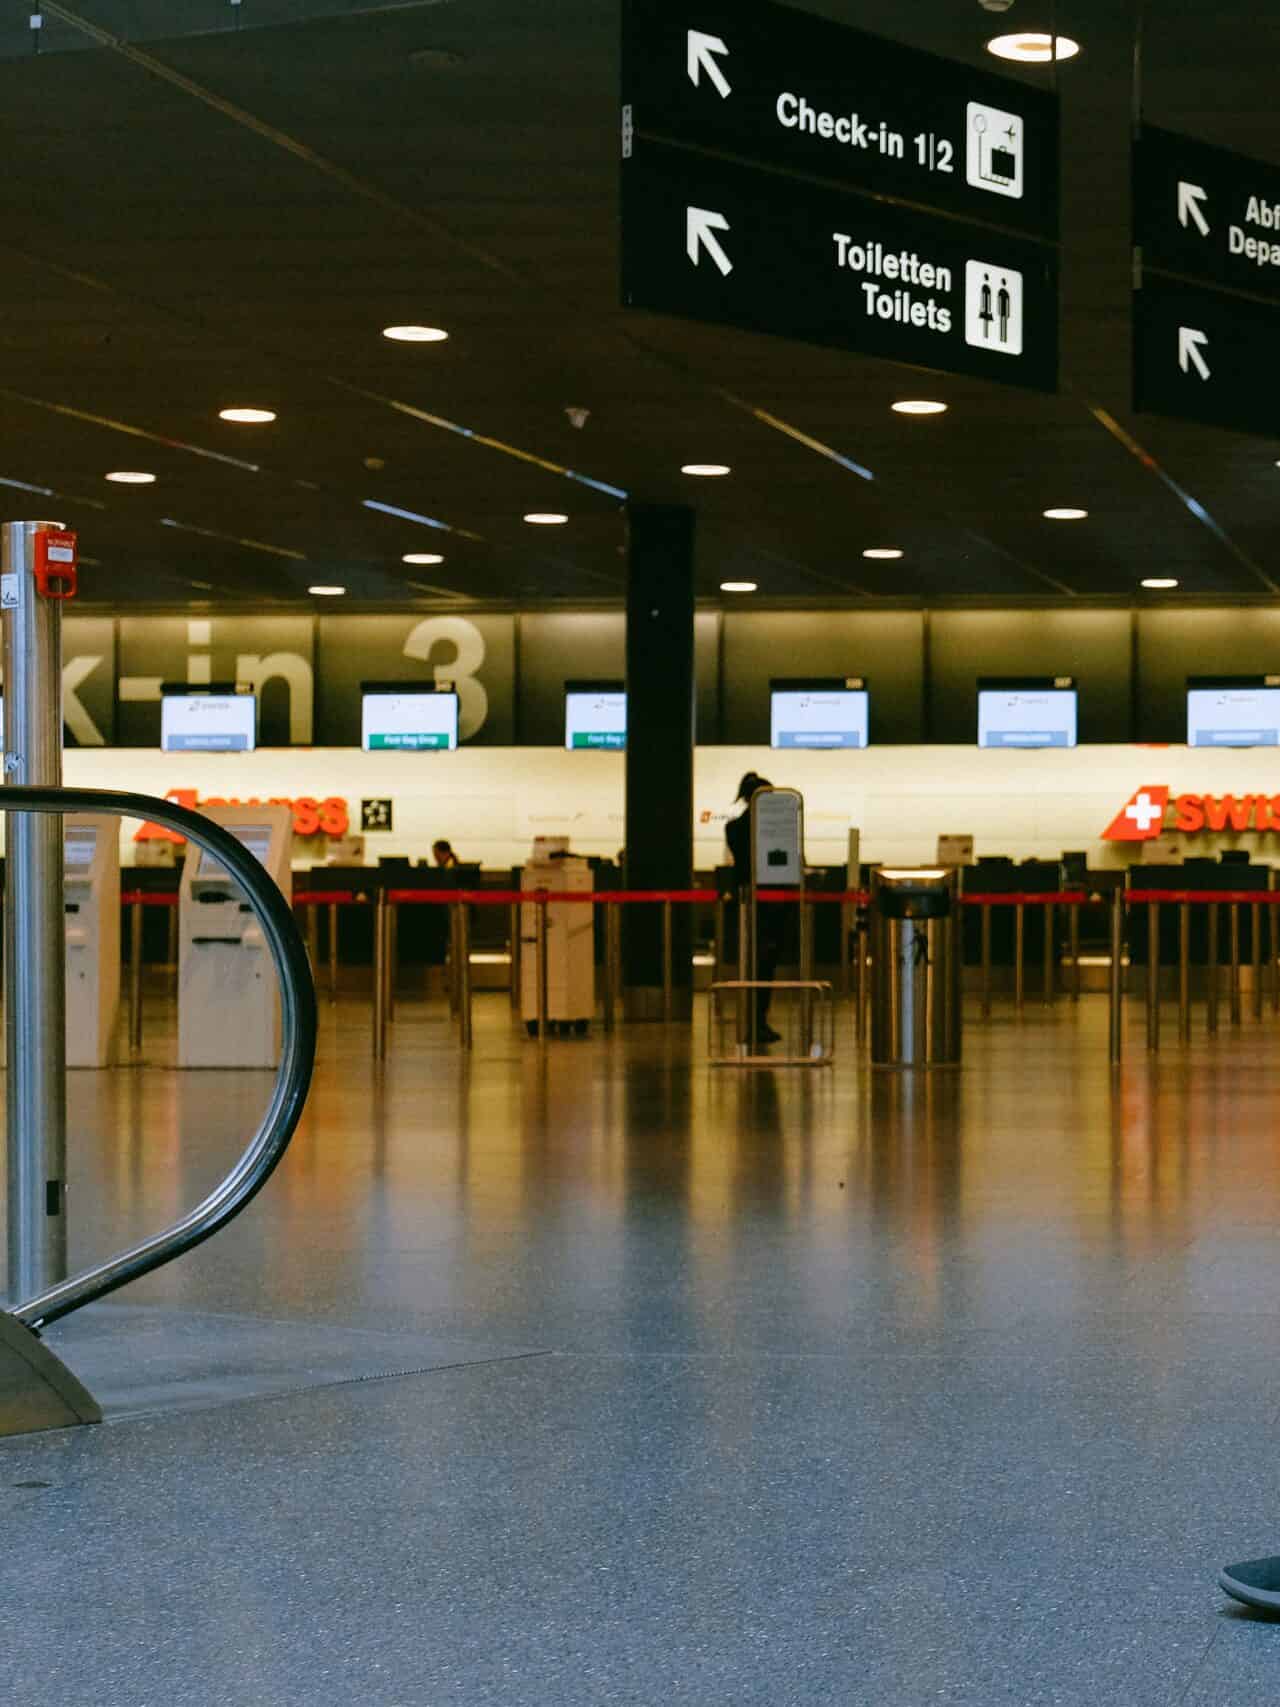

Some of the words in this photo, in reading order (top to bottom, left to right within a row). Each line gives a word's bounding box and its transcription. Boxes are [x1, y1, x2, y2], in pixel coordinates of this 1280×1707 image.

[776, 92, 903, 159] Check-in
[832, 232, 952, 293] Toiletten
[861, 281, 952, 333] Toilets
[404, 616, 488, 741] 3
